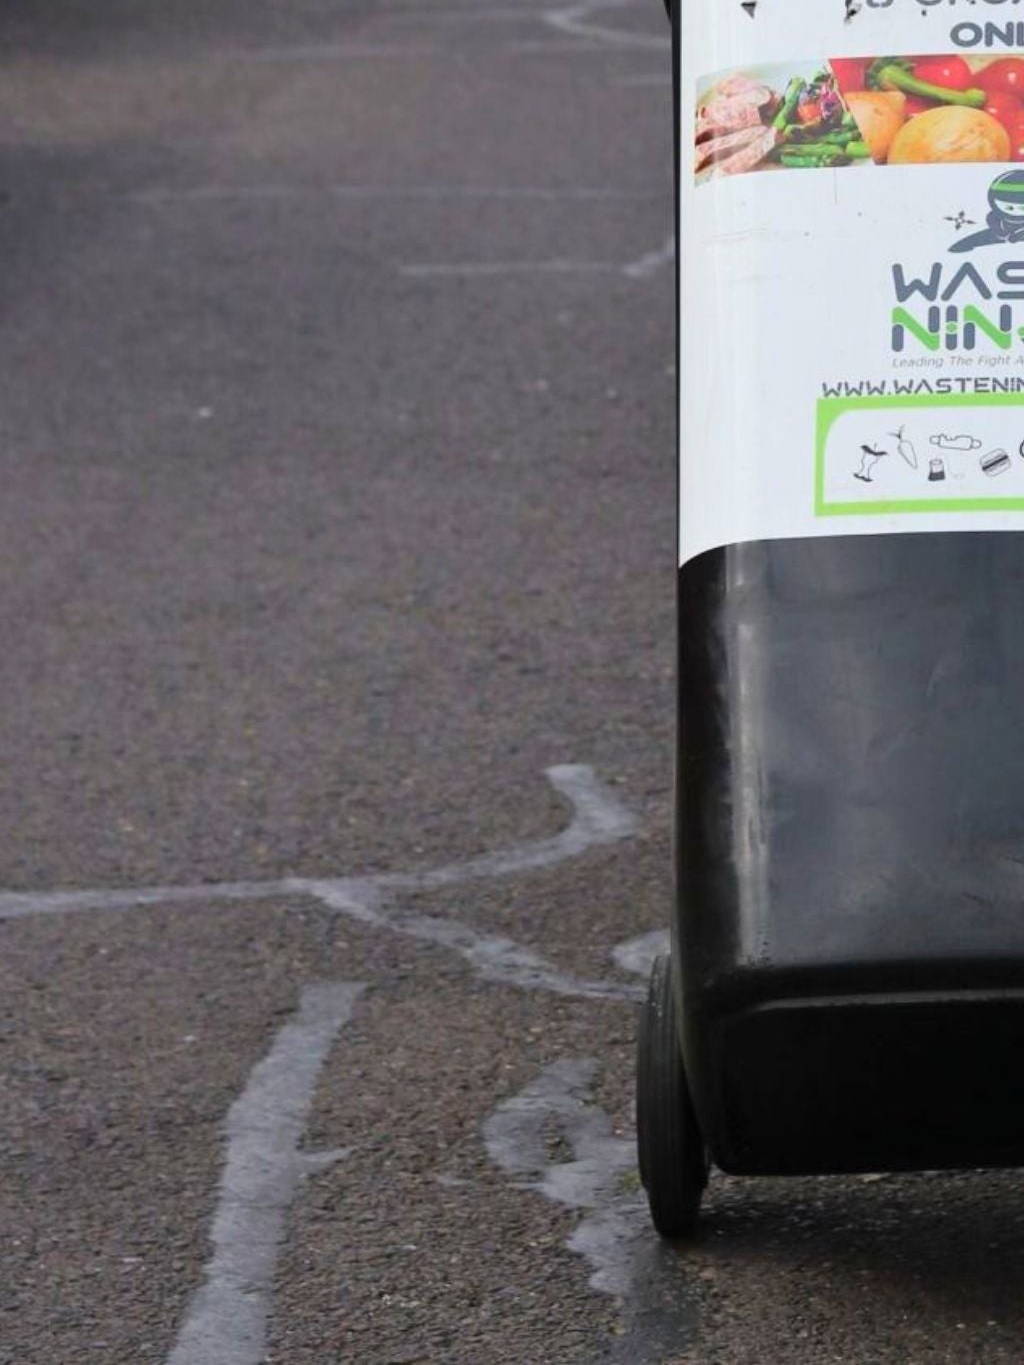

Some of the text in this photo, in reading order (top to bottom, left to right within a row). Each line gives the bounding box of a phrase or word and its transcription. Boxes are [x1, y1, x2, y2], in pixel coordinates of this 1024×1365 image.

[892, 356, 944, 369] Leading
[949, 355, 974, 366] The
[977, 354, 1011, 368] Fight
